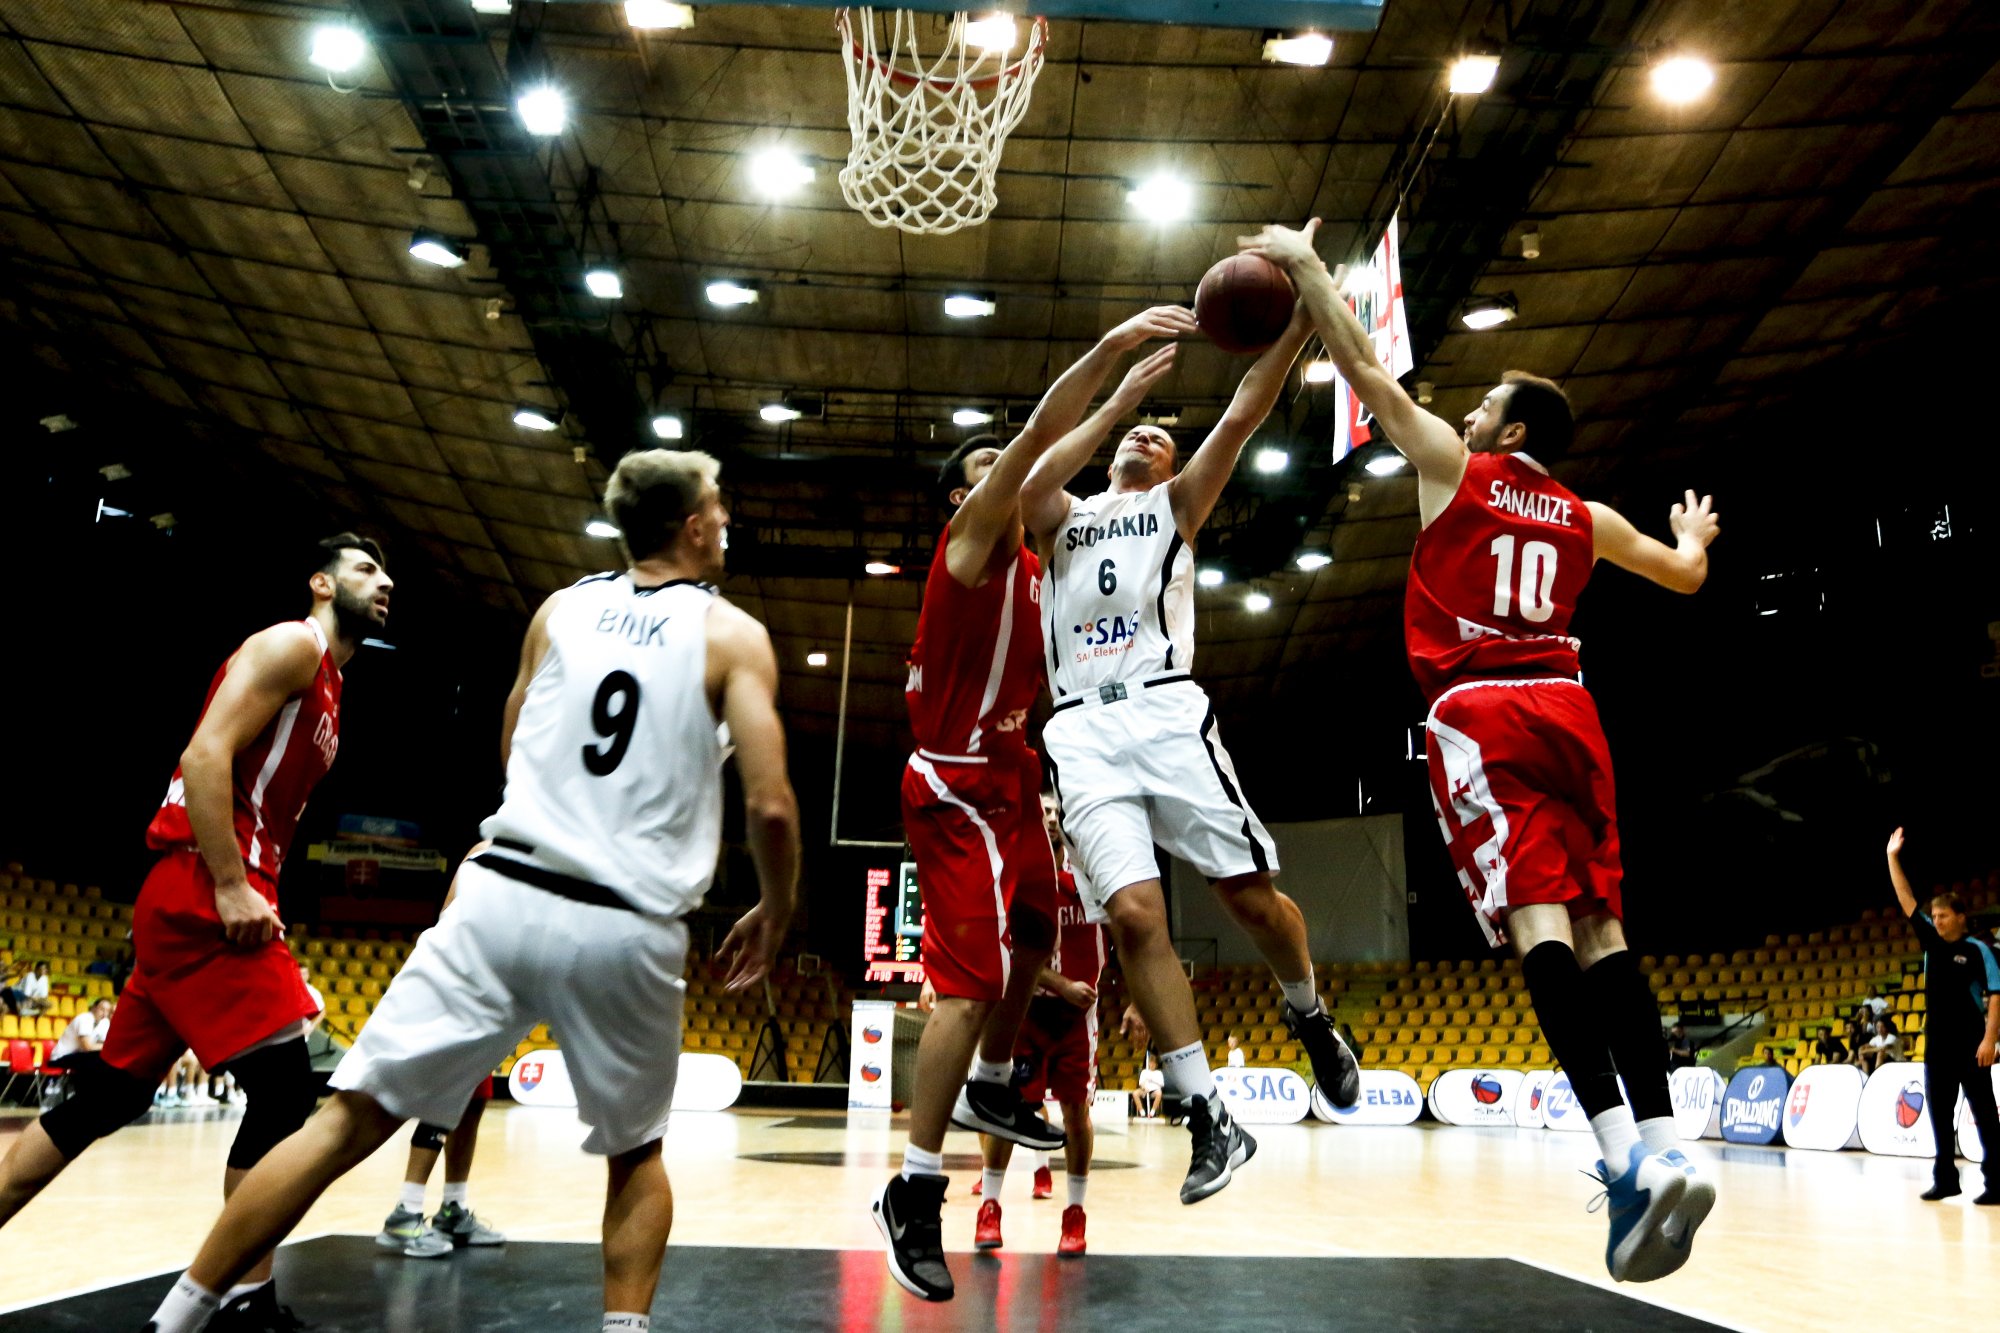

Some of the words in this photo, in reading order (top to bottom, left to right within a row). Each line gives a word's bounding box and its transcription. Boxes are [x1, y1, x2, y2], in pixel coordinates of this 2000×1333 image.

[1487, 480, 1573, 527] SANADZE
[1098, 558, 1117, 597] 6
[1490, 533, 1558, 623] 10
[1095, 609, 1139, 645] SAG
[582, 669, 641, 777] 9
[1242, 1075, 1296, 1101] SAG
[1366, 1089, 1416, 1106] ELBA
[1681, 1076, 1711, 1110] SAG
[1722, 1096, 1781, 1131] SPALDING
